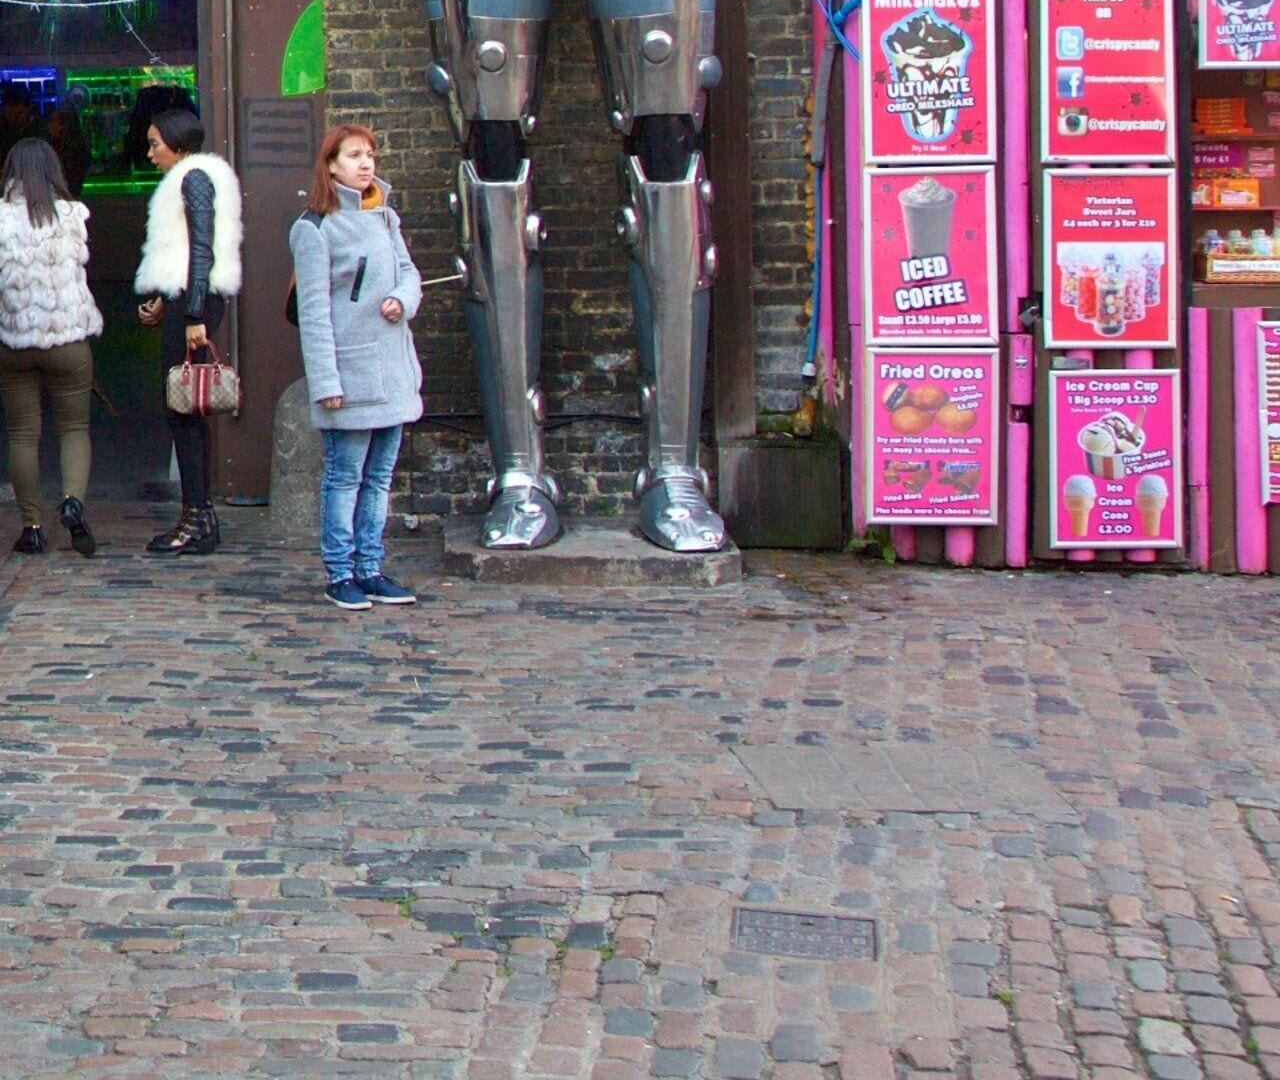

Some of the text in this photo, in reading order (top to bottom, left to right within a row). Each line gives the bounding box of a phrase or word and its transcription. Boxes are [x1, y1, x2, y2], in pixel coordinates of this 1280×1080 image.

[1215, 21, 1276, 37] ULTIMATE
[1083, 37, 1161, 52] @crispycandy
[886, 77, 972, 98] ULTIMATE
[886, 96, 975, 113] OREO MILKSHAKE
[1087, 118, 1166, 131] @crispycandy
[1085, 196, 1134, 205] Victorian
[1082, 207, 1137, 216] Sweet Jars
[1076, 219, 1100, 227] each
[1121, 219, 1138, 227] for
[900, 255, 949, 282] ICED
[894, 280, 967, 311] COFFEE
[931, 314, 956, 326] Large
[880, 363, 984, 380] Fried Oreos
[1065, 379, 1160, 393] Ice Cream Cup
[1073, 395, 1091, 407] Big
[1092, 395, 1125, 406] Scoop
[1127, 394, 1158, 405] £2.50
[1123, 454, 1142, 464] Free
[1106, 483, 1124, 493] Ice
[1098, 496, 1133, 506] Cream
[1101, 510, 1129, 520] Cone
[1098, 524, 1133, 534] £2.00
